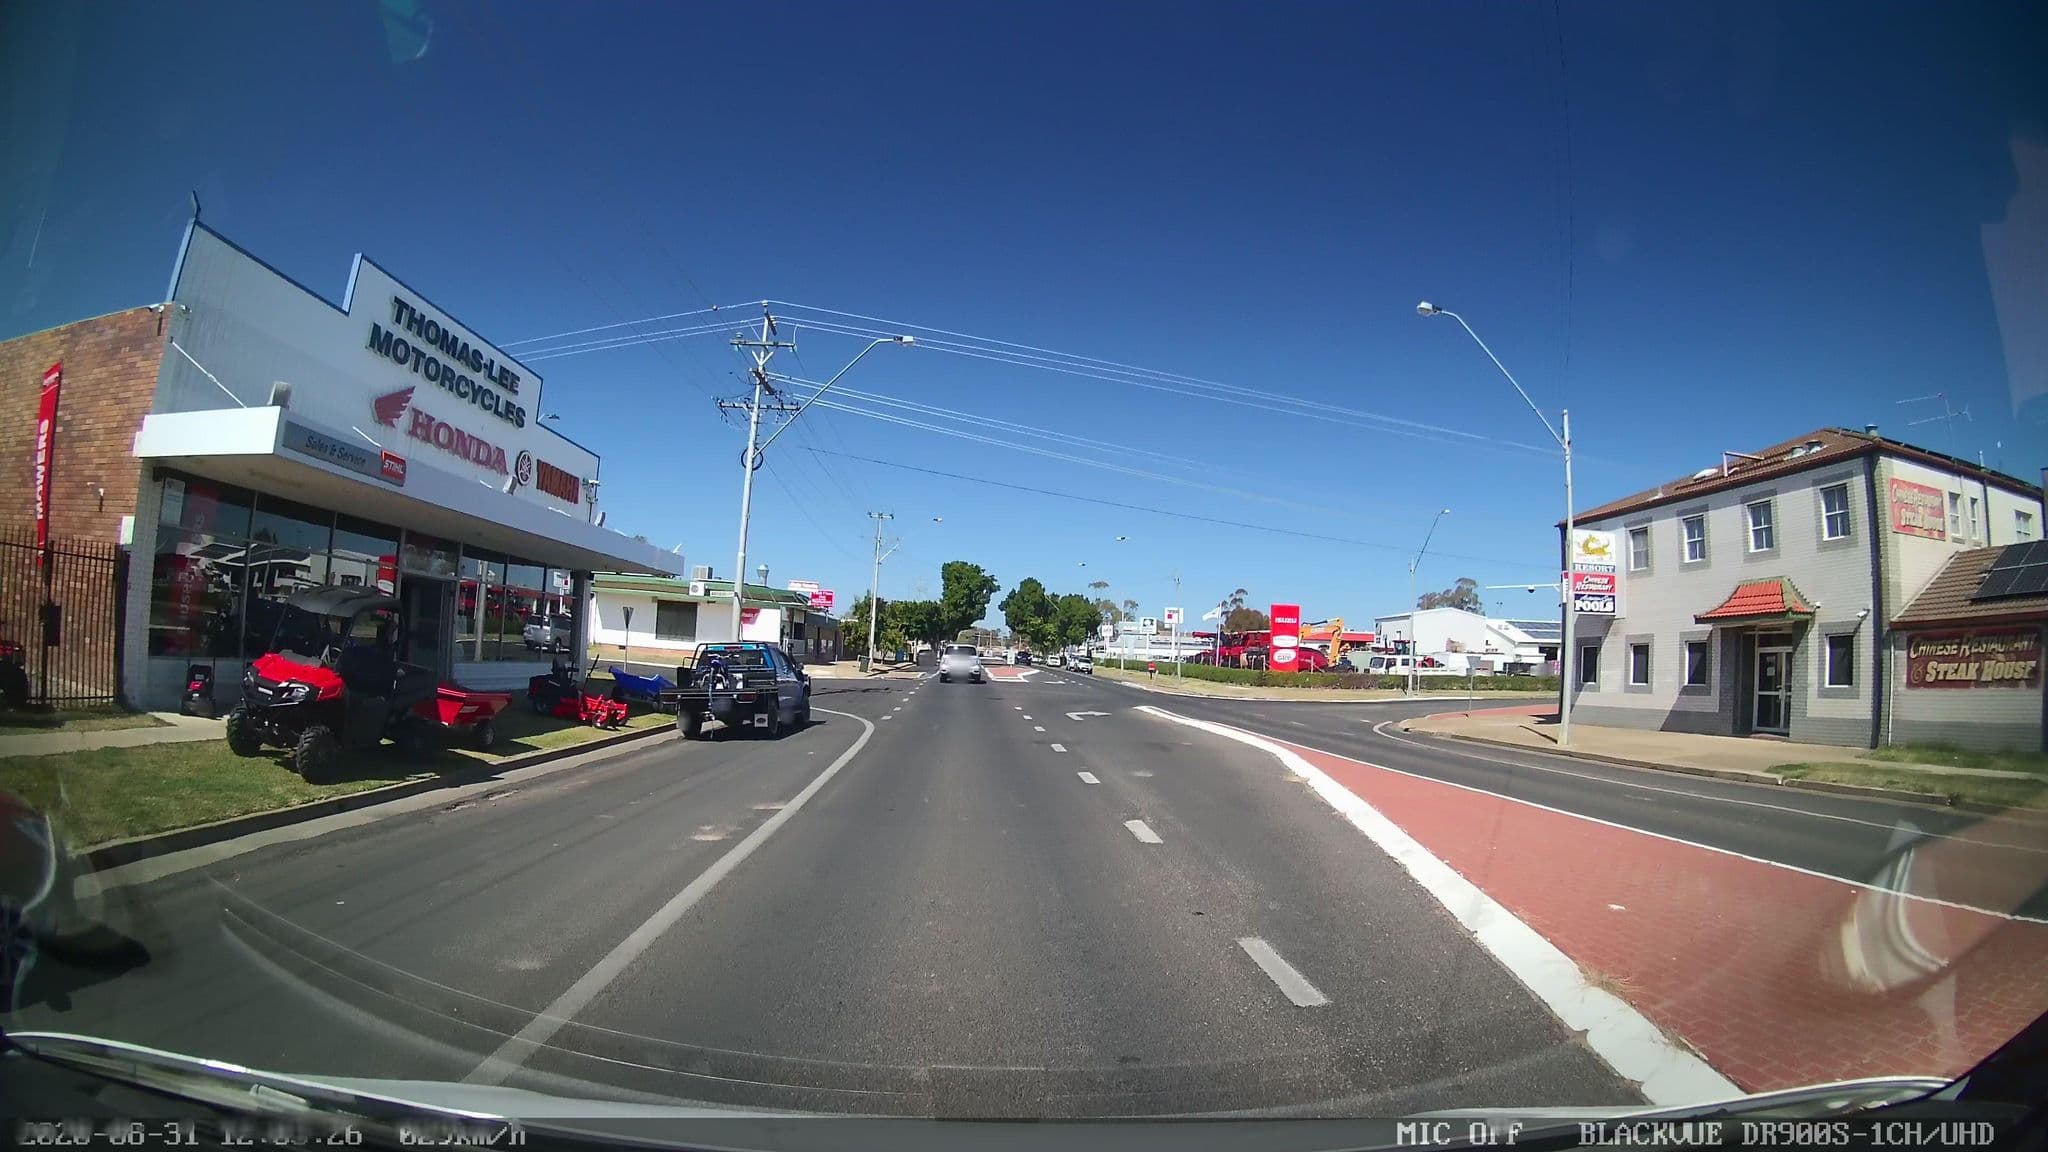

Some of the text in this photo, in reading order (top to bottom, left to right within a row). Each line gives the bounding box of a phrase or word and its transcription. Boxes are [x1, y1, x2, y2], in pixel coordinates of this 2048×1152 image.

[393, 296, 521, 397] THOMAS-LEE
[368, 322, 527, 429] MOTORCYCLES
[305, 435, 329, 453] Sales
[407, 406, 509, 475] HONDA
[383, 459, 404, 474] STIHL
[536, 458, 580, 505] YAMAHA
[1574, 564, 1614, 573] RESORT
[1575, 600, 1614, 612] POOLS
[1909, 639, 1960, 659] CHINESE
[1925, 661, 1980, 682] STEAK
[1981, 660, 2037, 681] HOUSE
